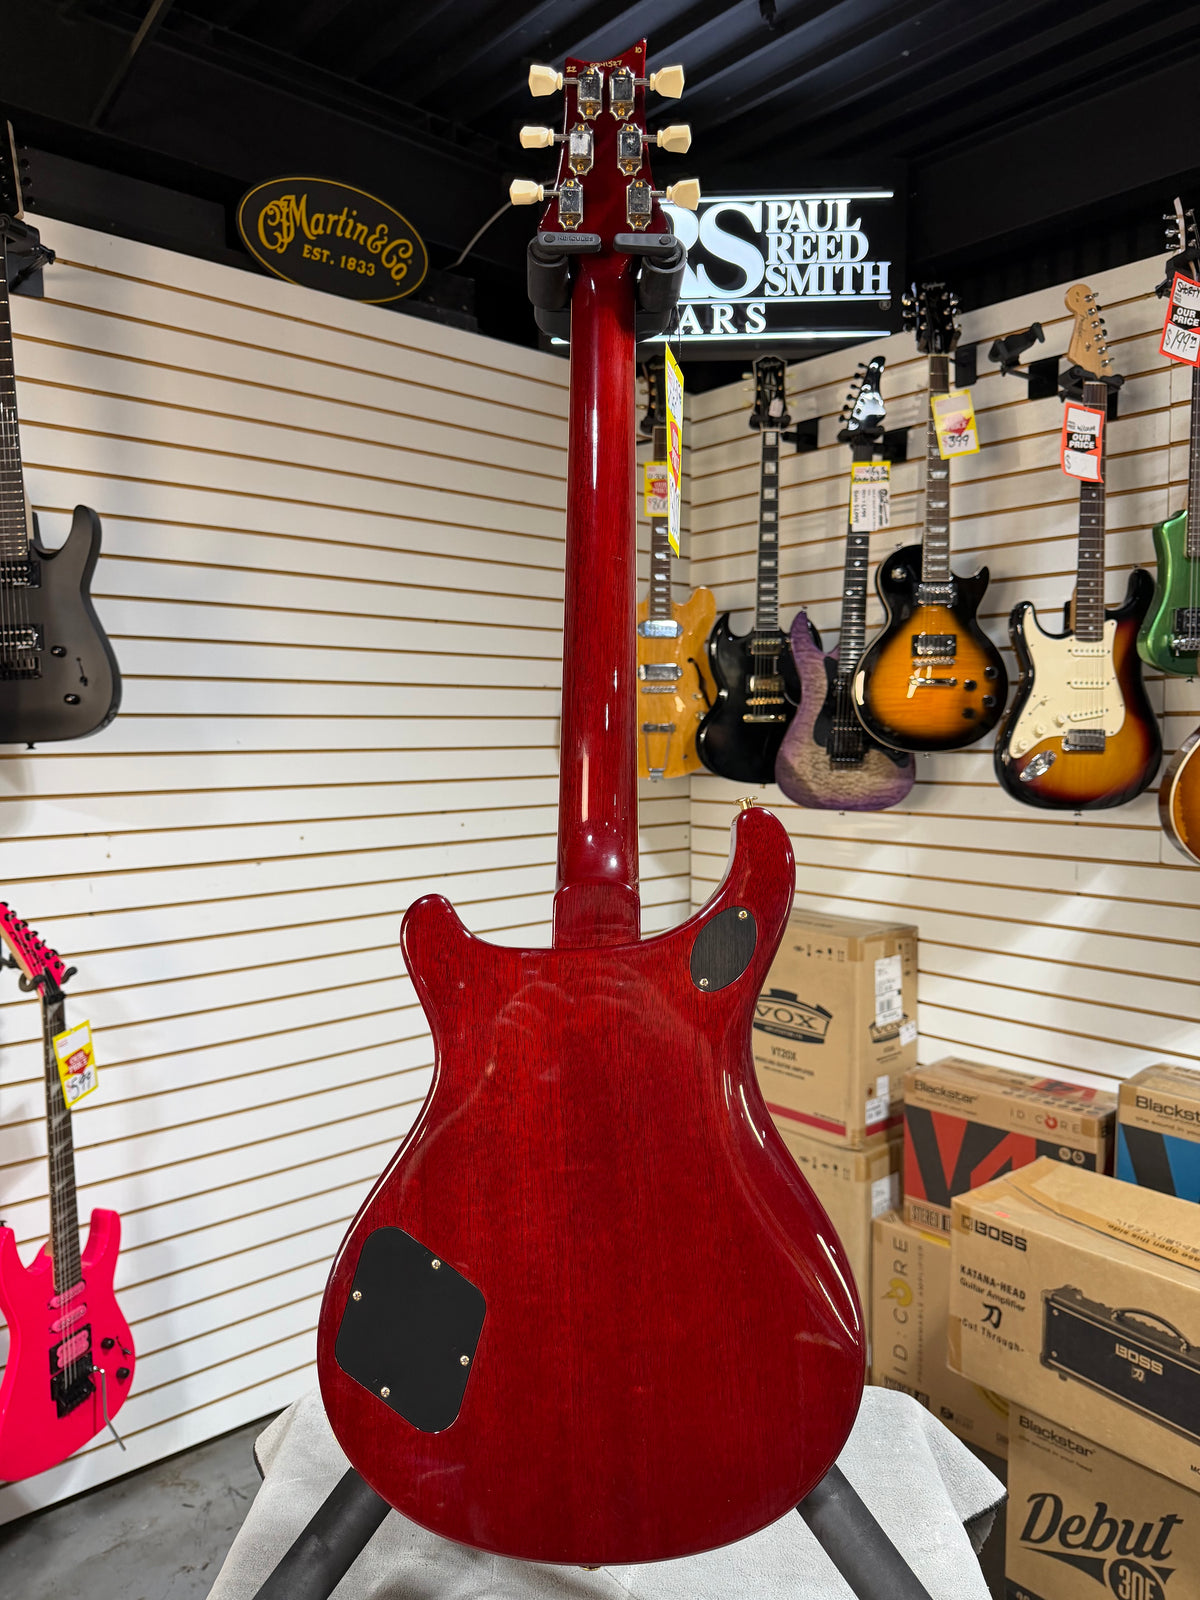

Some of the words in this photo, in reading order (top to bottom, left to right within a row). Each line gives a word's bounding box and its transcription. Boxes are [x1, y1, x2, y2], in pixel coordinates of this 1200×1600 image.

[766, 199, 862, 233] PAUL
[302, 243, 335, 265] EST.
[340, 255, 376, 277] 1833
[766, 231, 869, 265] REED
[764, 261, 891, 296] SMITH
[680, 303, 767, 335] ARS
[1172, 314, 1200, 327] PRICE
[1176, 307, 1196, 318] OUR
[1069, 441, 1095, 449] PRICE
[1072, 433, 1091, 442] OUR
[757, 1004, 818, 1031] VOX
[914, 1080, 976, 1104] Blackstar
[912, 1206, 939, 1228] STEREO
[974, 1219, 1027, 1252] BOSS
[960, 1264, 1026, 1300] KATANA-HEAD
[960, 1277, 985, 1295] Guitar
[986, 1289, 1026, 1312] Amplifier
[981, 1302, 1002, 1329] 刀
[1115, 1342, 1164, 1375] BOSS
[1019, 1415, 1093, 1457] Blackstar
[1019, 1492, 1184, 1561] Debut
